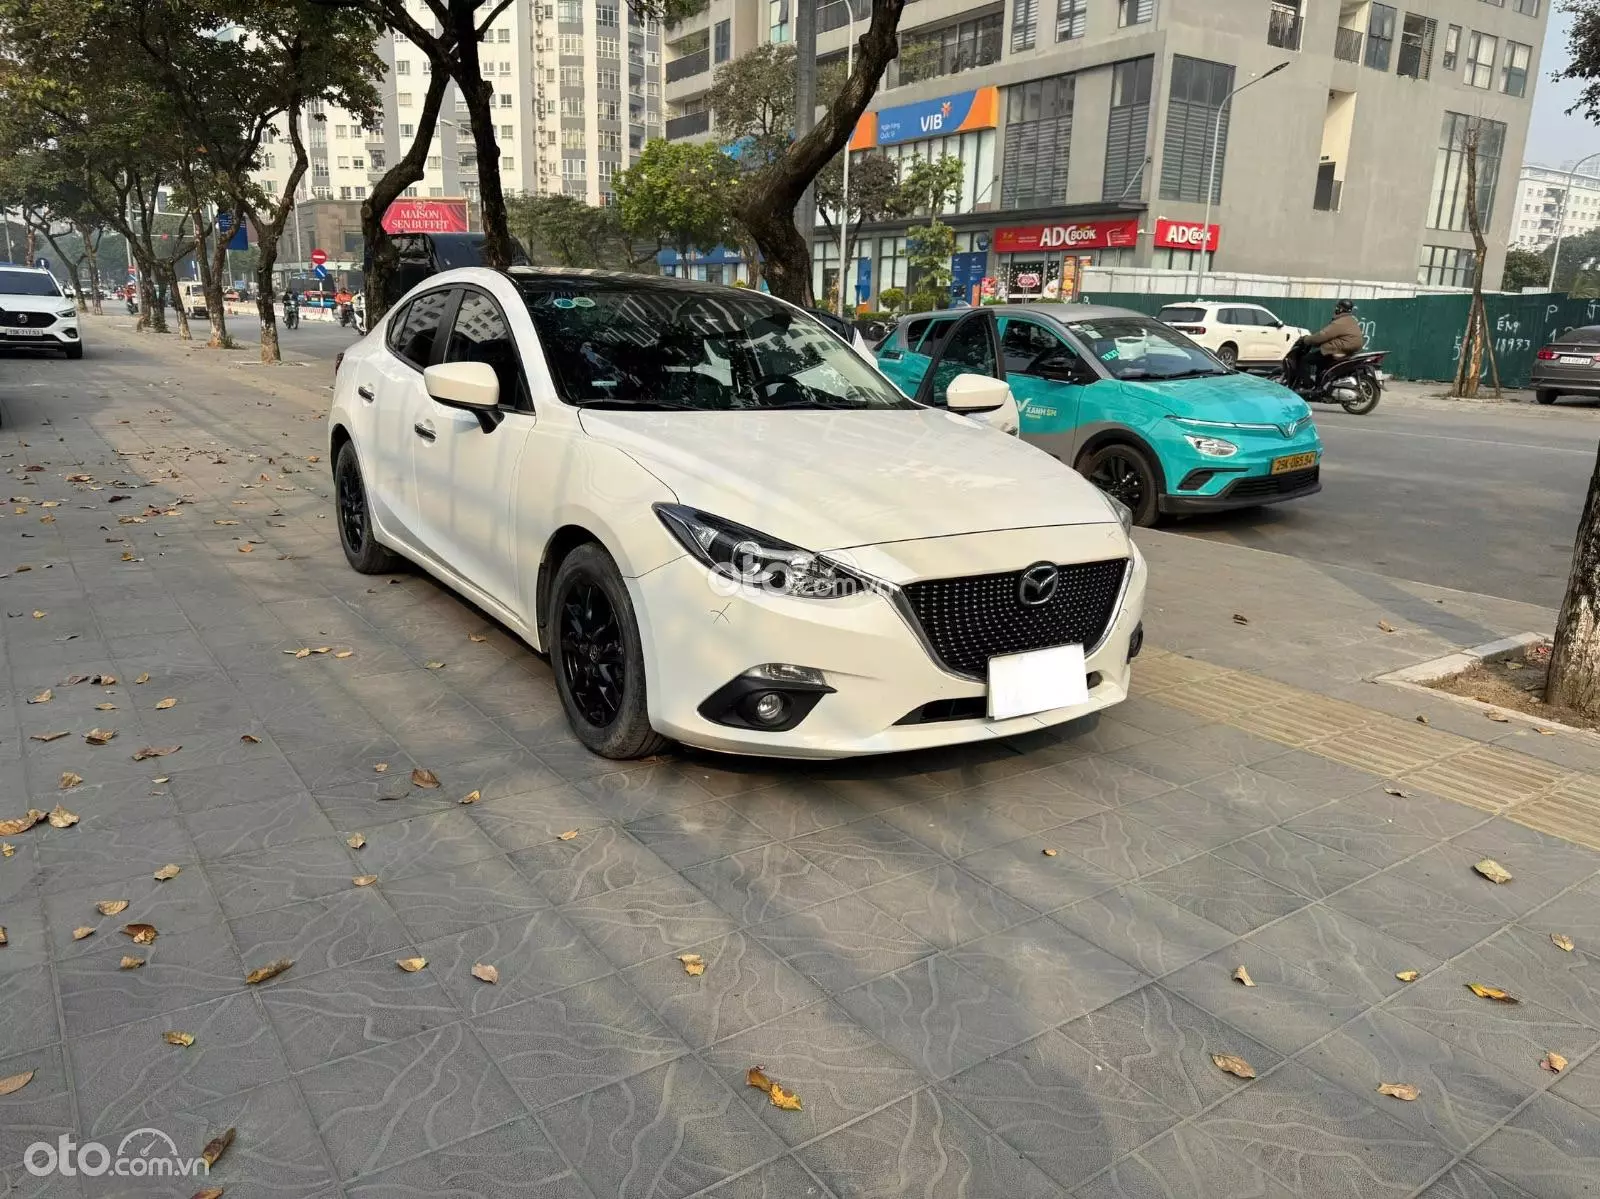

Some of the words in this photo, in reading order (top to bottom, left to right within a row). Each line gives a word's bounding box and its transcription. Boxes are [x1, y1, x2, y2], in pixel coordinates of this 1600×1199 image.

[920, 113, 943, 132] VIB
[400, 209, 440, 219] MAISON
[392, 220, 410, 229] SEN
[412, 220, 450, 229] BUFFET
[1026, 406, 1046, 417] XANH
